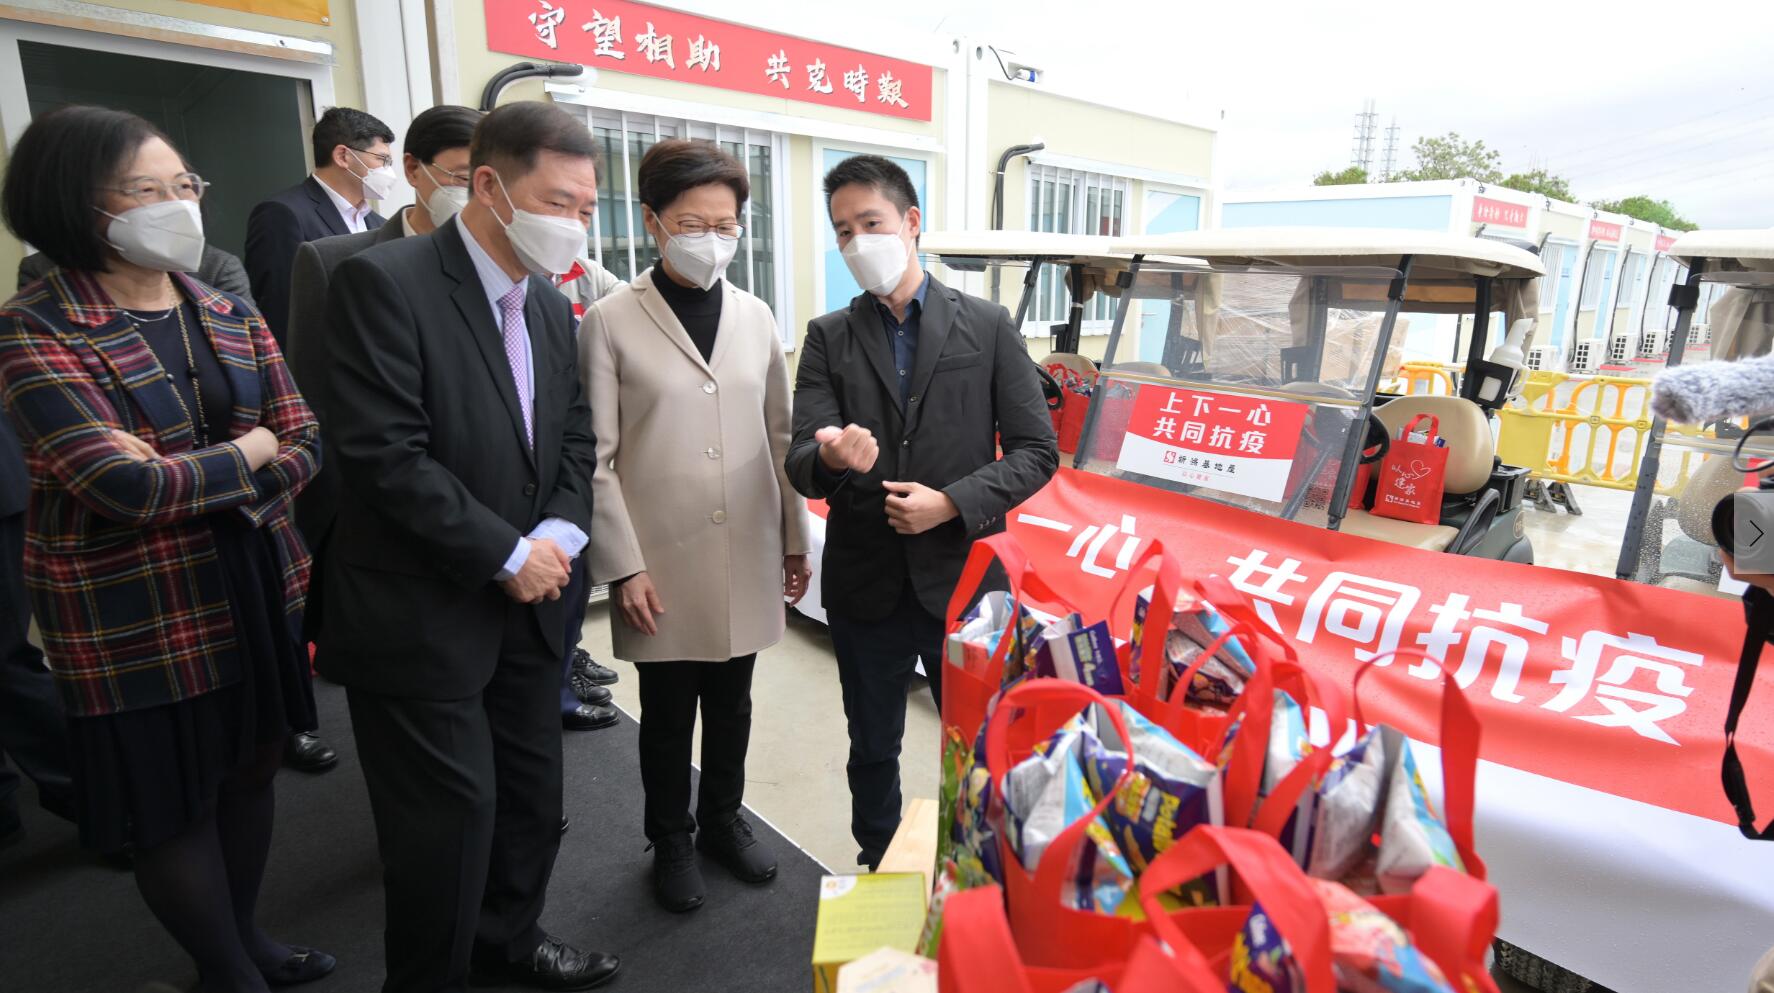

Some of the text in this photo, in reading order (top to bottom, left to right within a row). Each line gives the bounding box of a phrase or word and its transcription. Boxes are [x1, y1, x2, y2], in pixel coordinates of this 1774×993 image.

[528, 0, 910, 109] 守望相助 共克時艱
[1152, 416, 1268, 455] 共同抗疫
[1159, 391, 1272, 427] 上下一心
[1017, 513, 1142, 579] 一心
[1209, 548, 1704, 747] 共同抗疫
